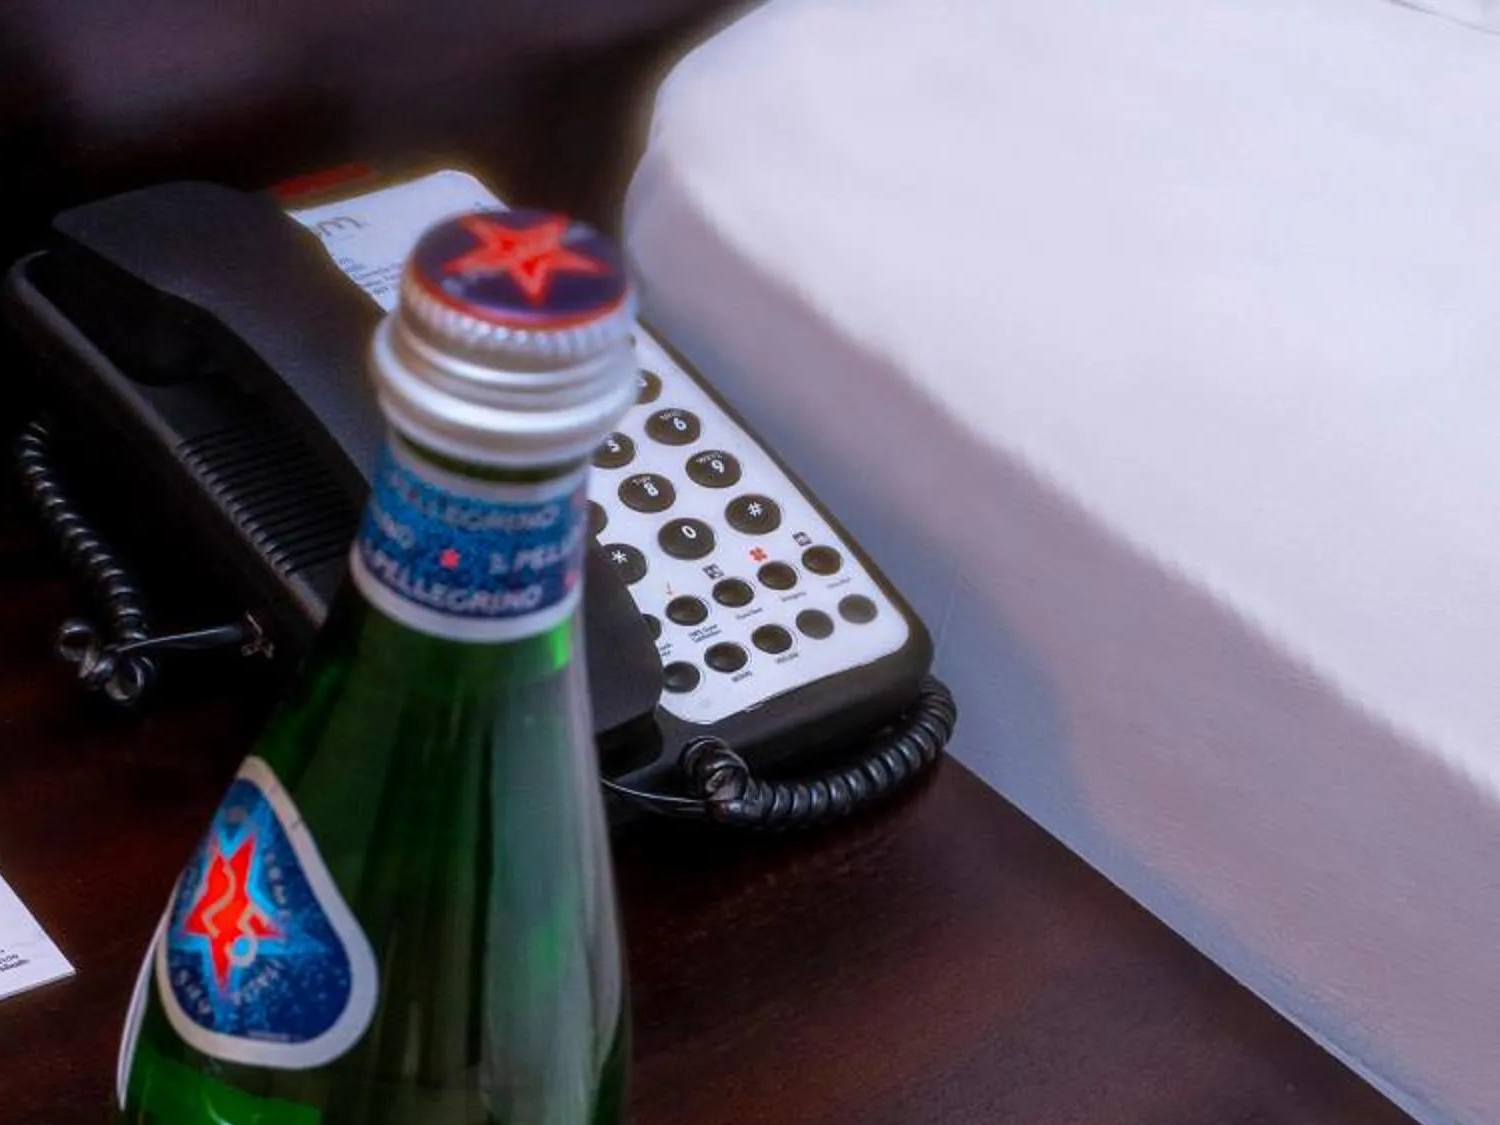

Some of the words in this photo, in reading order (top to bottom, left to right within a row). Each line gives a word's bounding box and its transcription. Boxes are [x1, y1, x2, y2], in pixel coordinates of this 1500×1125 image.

[673, 417, 688, 431] 6
[711, 459, 725, 474] 9
[643, 481, 659, 497] 8
[747, 502, 763, 518] #
[681, 525, 697, 540] 0
